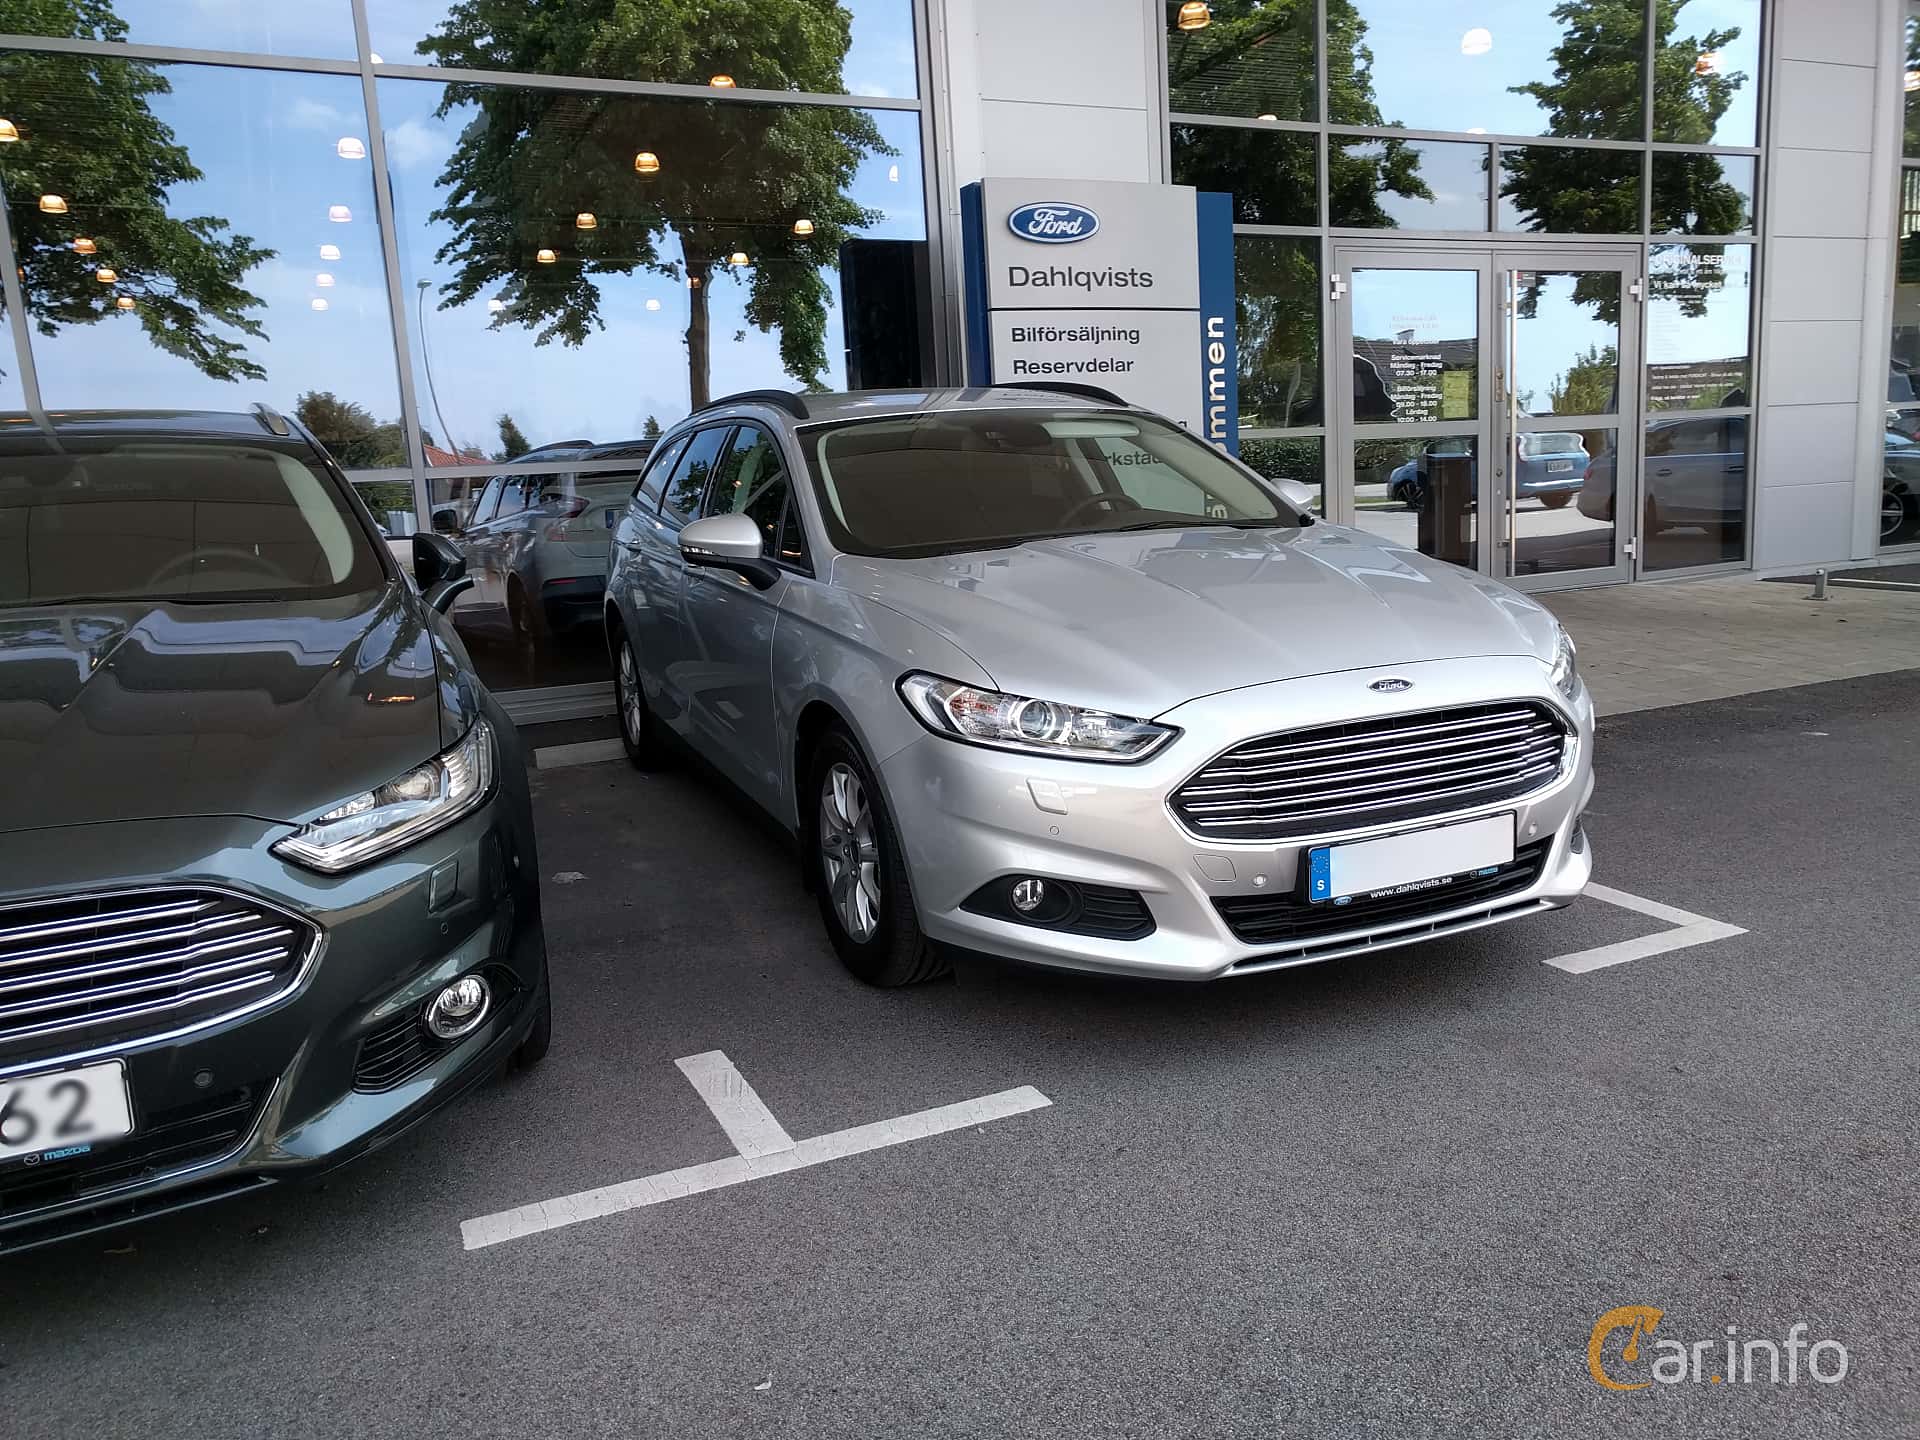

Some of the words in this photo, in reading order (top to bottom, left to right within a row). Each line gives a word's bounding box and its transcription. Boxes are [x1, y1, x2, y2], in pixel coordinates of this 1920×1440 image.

[1027, 207, 1083, 236] Ford
[1008, 266, 1153, 291] Dahlqvists
[1011, 326, 1141, 345] Bilförsäljning
[1012, 358, 1134, 375] Reservdelar
[1316, 880, 1325, 891] S
[1370, 876, 1453, 899] www.dahlqvists.se
[44, 1144, 92, 1161] mazda
